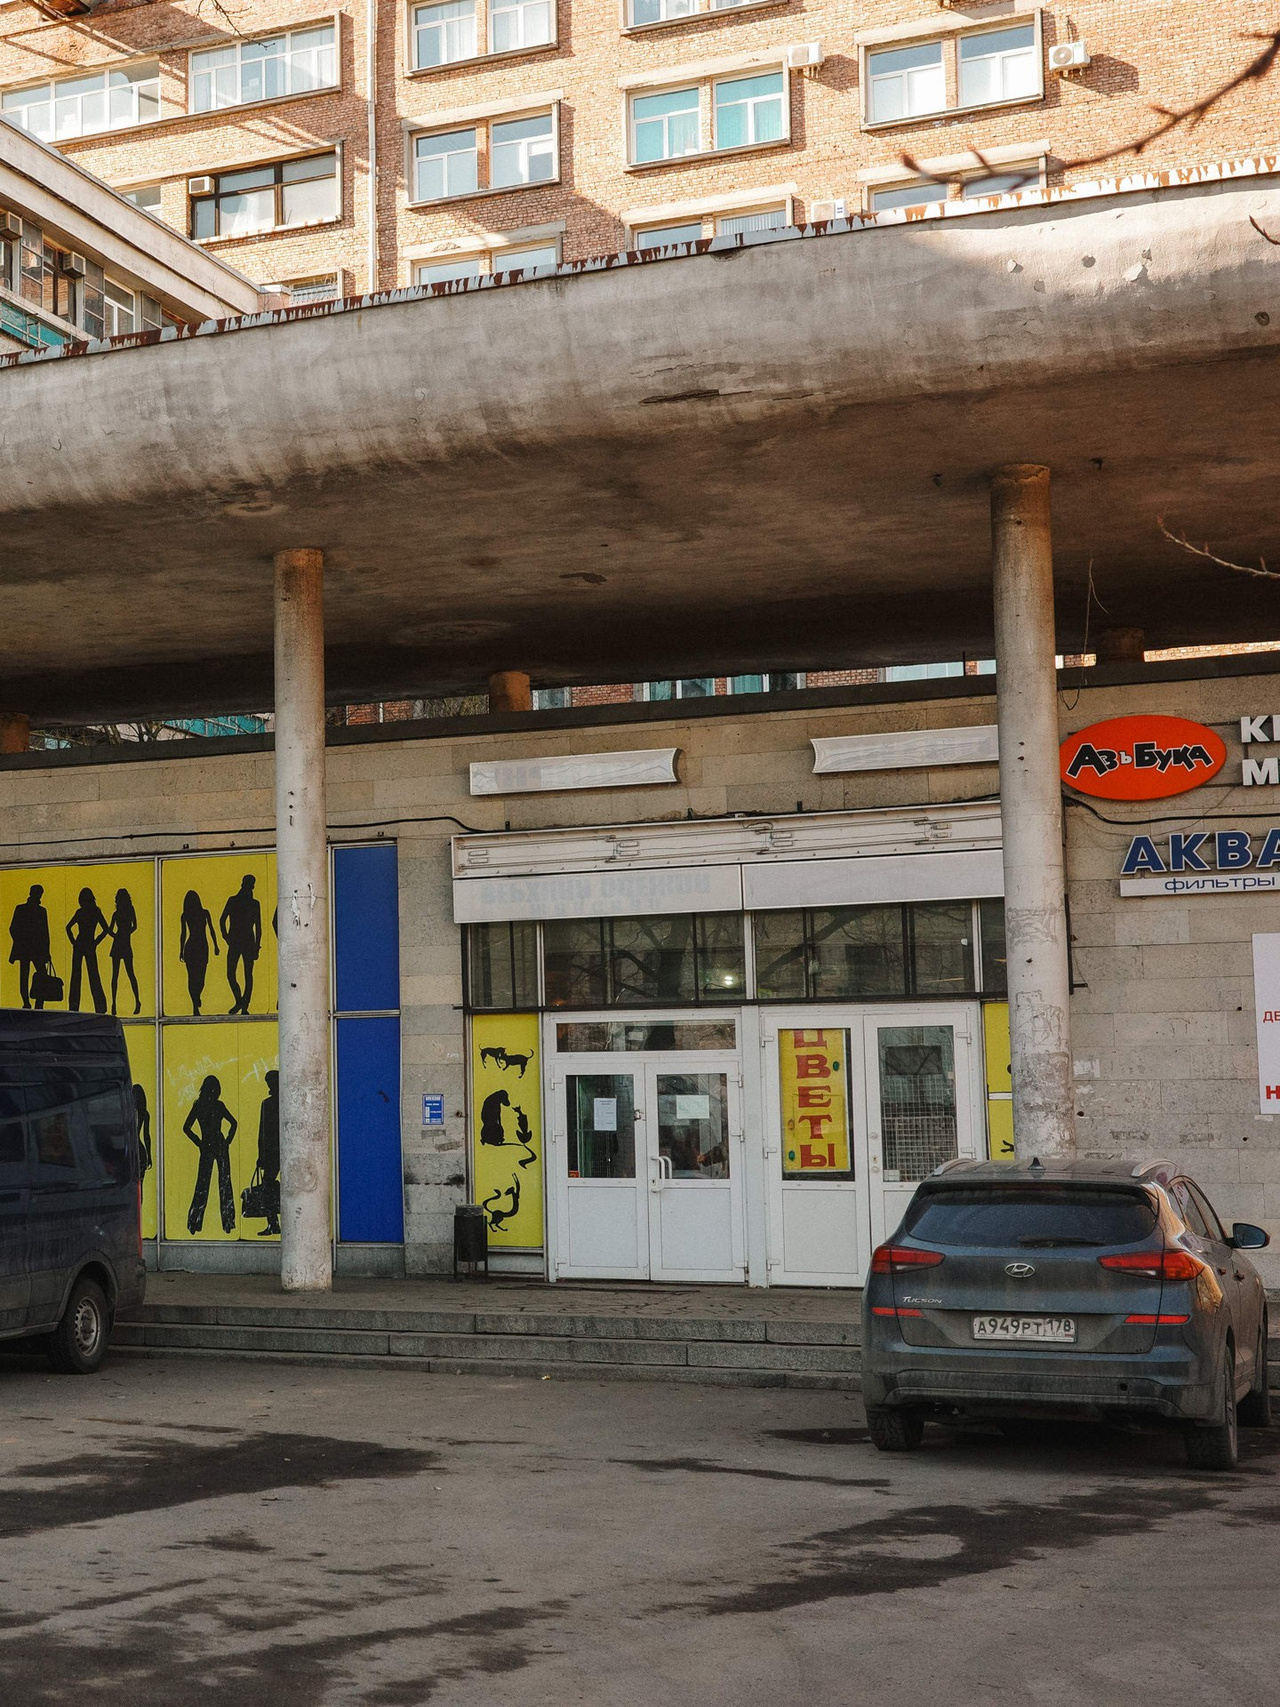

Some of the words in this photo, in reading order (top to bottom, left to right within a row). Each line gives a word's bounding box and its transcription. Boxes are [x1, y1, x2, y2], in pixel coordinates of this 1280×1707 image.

[1240, 714, 1280, 743] К
[1164, 877, 1276, 893] фильтры
[793, 1028, 836, 1168] ЦВЕТЫ
